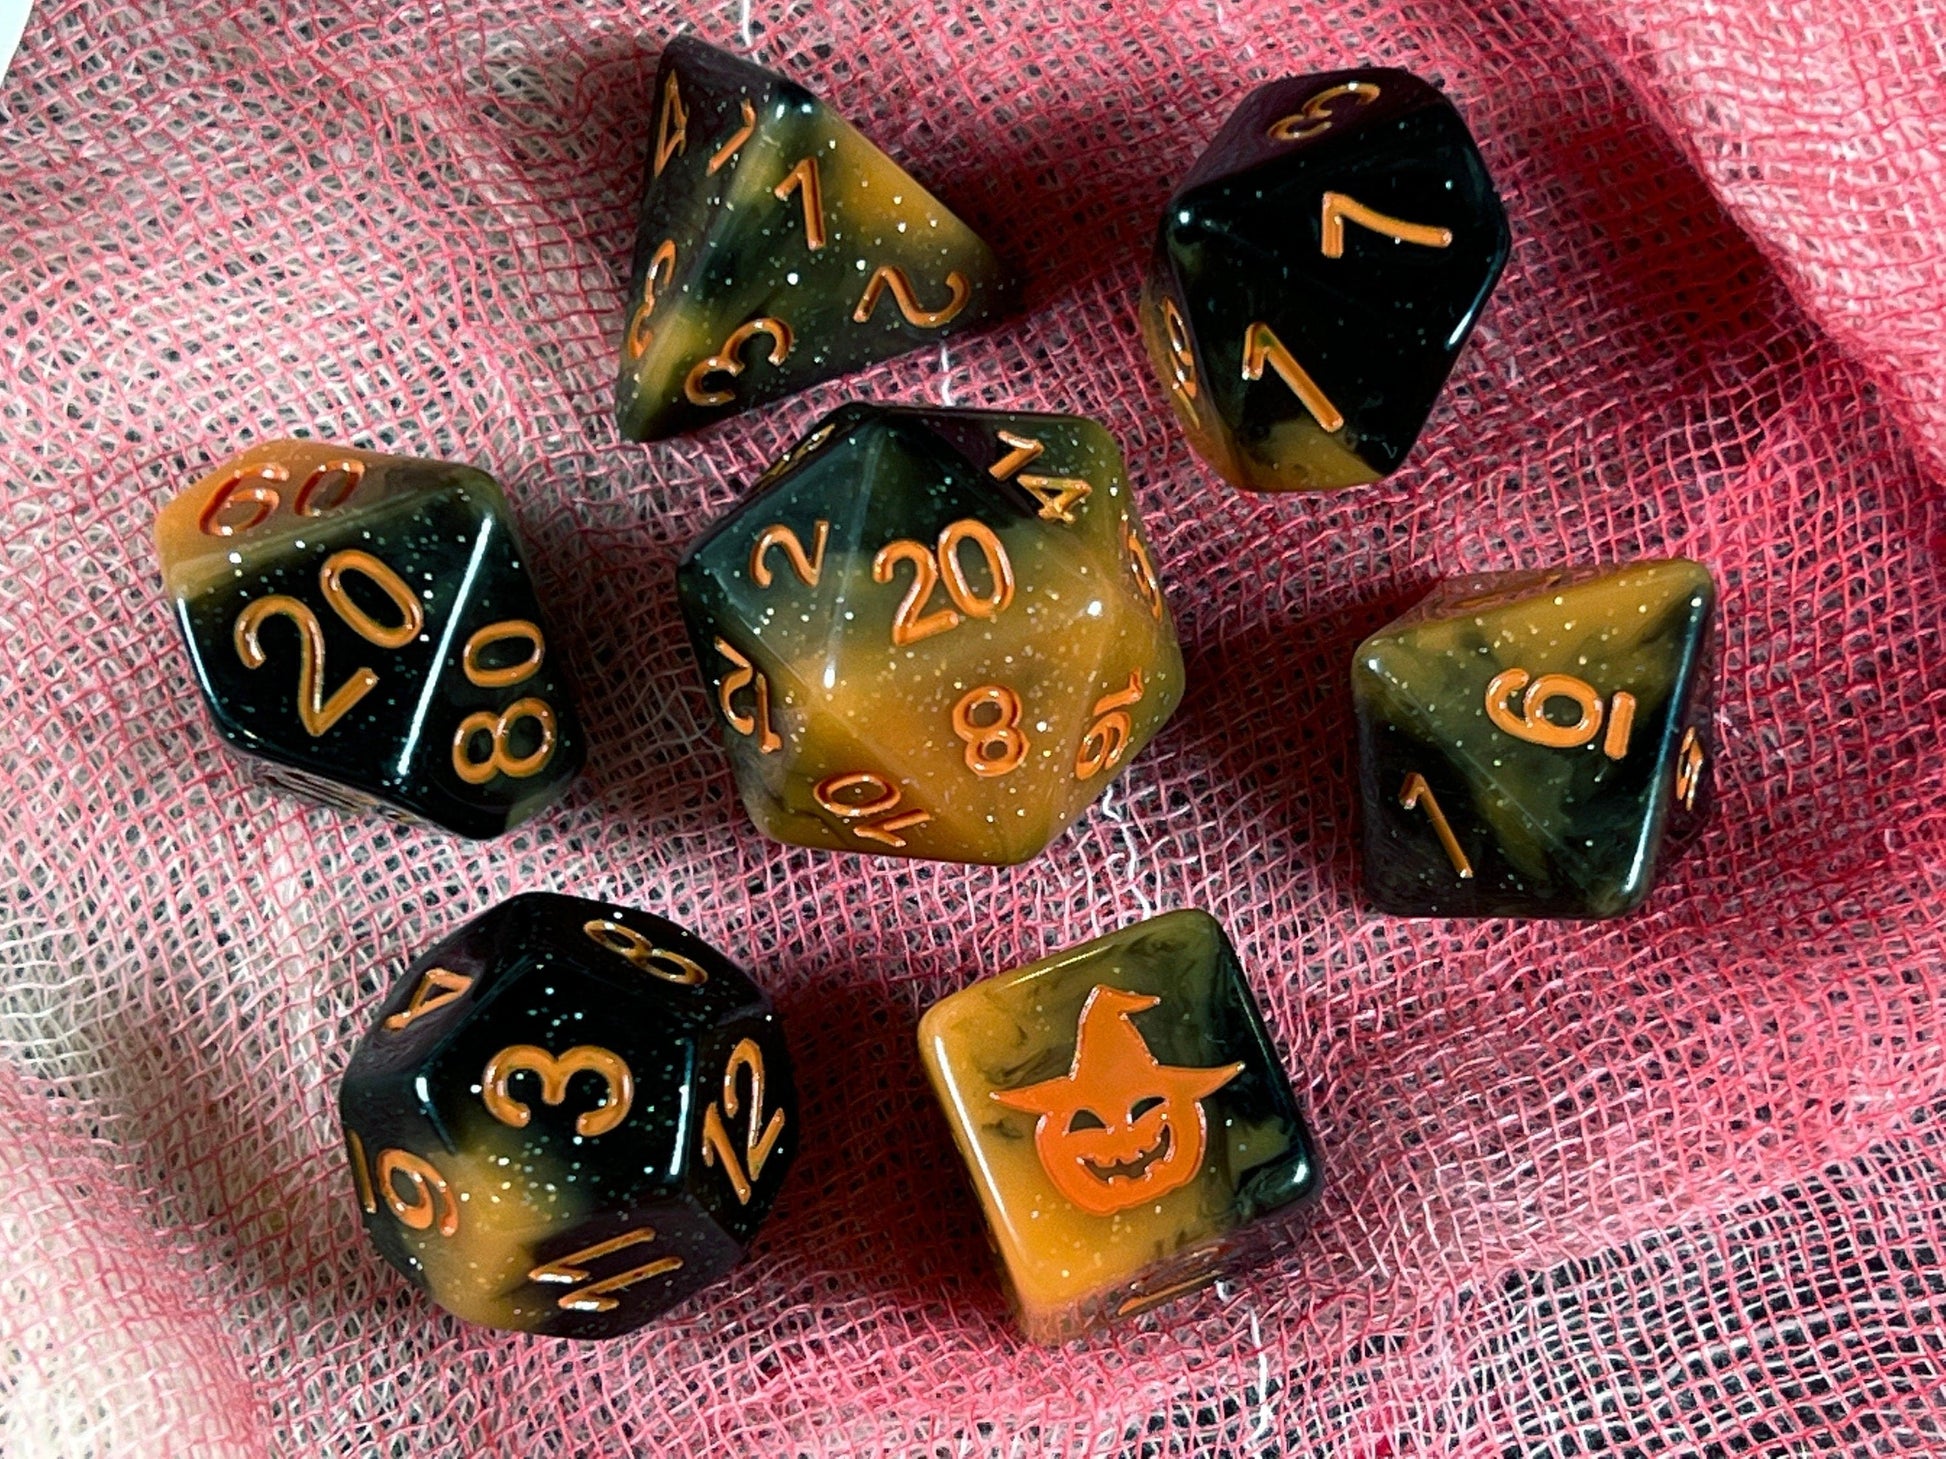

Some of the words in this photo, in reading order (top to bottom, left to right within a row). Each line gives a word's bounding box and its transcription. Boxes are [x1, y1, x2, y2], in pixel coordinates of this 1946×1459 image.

[1267, 82, 1381, 140] 3
[774, 157, 827, 250] 1
[1321, 191, 1453, 259] 7
[628, 239, 676, 360] 3
[853, 265, 971, 328] 2
[684, 317, 795, 406] 3
[200, 459, 366, 537] 60
[989, 430, 1093, 524] 14
[750, 520, 829, 588] 2
[873, 518, 1015, 646] 20
[234, 549, 425, 737] 20
[452, 619, 558, 784] 80
[952, 684, 1031, 777] 8
[813, 771, 932, 848] 10
[1400, 773, 1473, 879] 1
[583, 919, 708, 985] 8
[482, 1044, 634, 1137] 3
[702, 1037, 785, 1205] 12
[529, 1226, 684, 1311] 11
